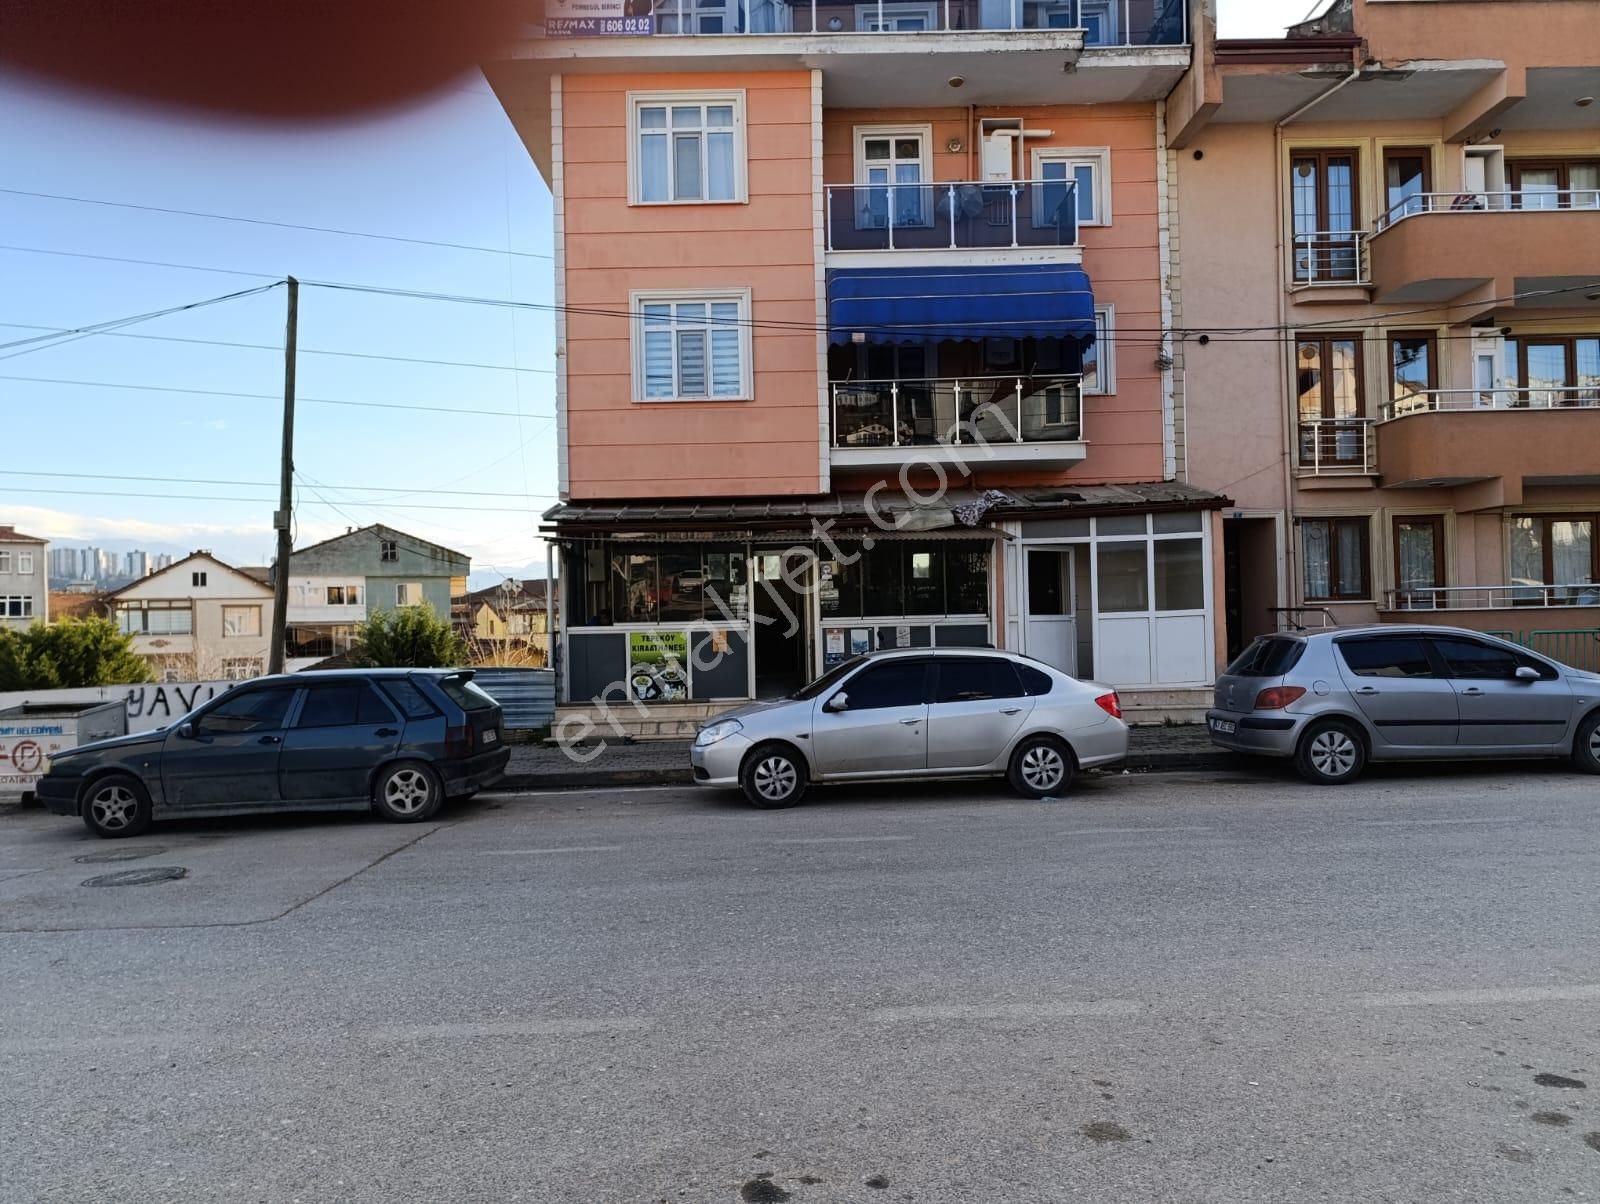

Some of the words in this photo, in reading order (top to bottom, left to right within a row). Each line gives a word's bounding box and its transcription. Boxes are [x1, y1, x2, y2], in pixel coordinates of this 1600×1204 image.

[549, 19, 595, 29] RE/MAX
[607, 20, 623, 31] 606
[625, 19, 637, 31] 02
[638, 18, 650, 30] 02
